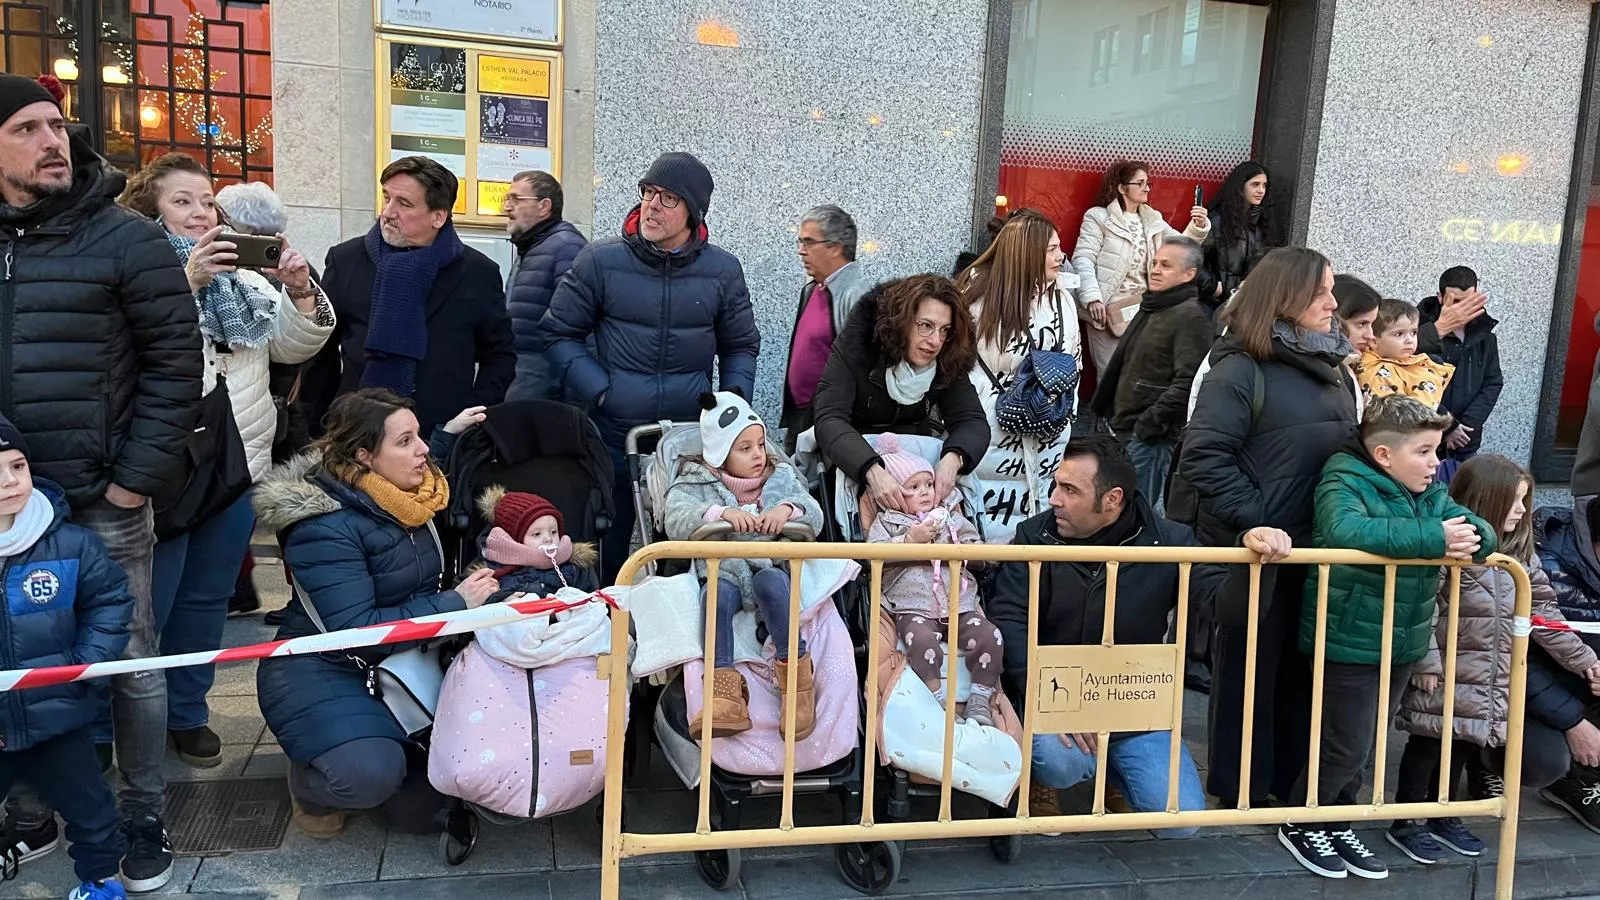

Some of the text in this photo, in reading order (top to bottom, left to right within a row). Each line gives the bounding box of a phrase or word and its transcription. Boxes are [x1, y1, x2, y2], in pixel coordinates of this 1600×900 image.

[473, 0, 512, 11] NOTARIO
[482, 65, 547, 77] ESTHER VAL PALACIO
[31, 579, 53, 598] 65
[1084, 671, 1173, 688] Ayuntamiento
[1083, 688, 1156, 701] de Huesca
